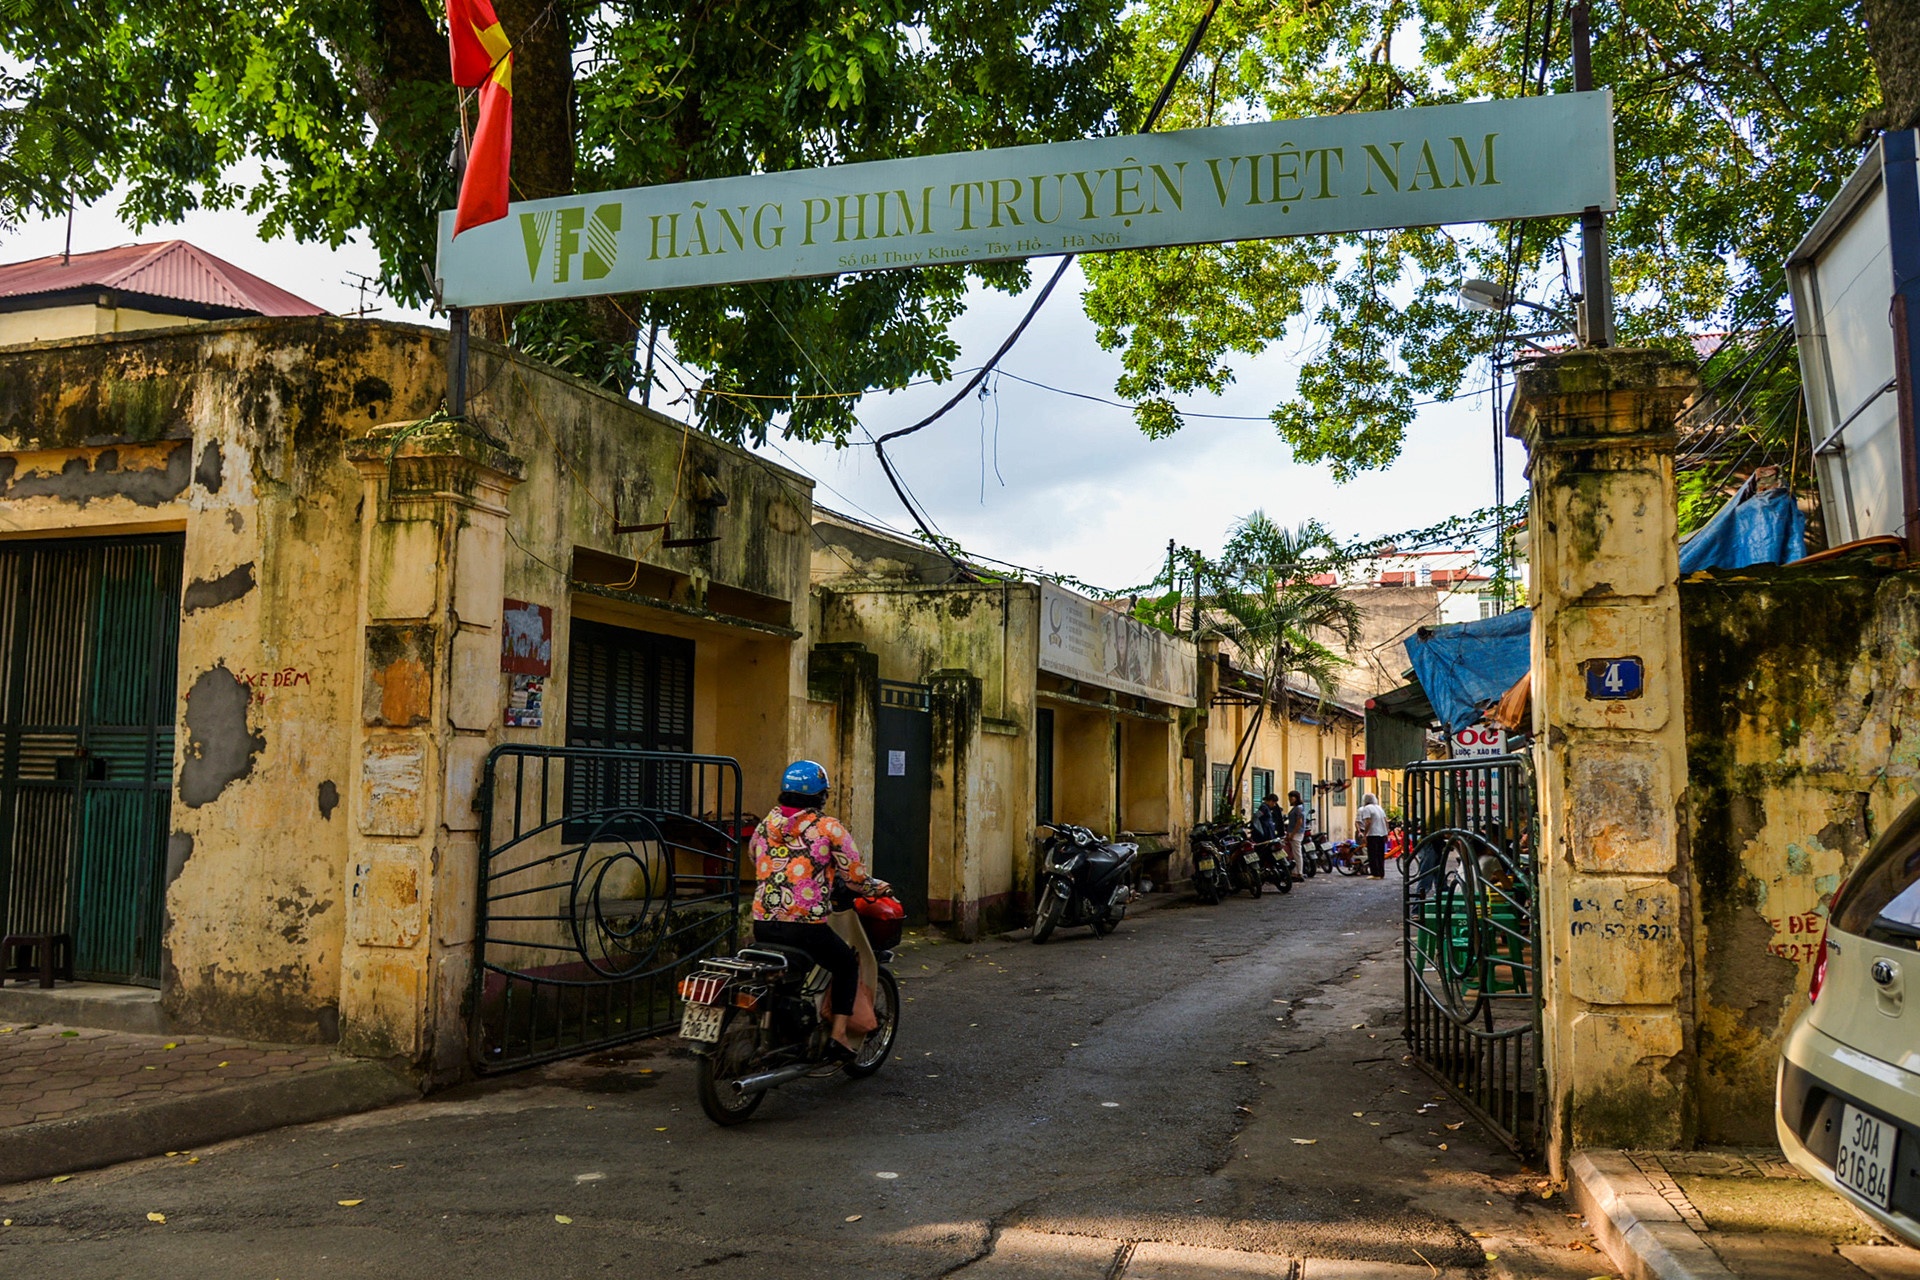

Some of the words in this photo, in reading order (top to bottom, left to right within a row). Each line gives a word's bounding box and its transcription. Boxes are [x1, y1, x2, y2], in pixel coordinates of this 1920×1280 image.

[646, 201, 787, 262] HÃNG
[800, 186, 937, 247] PHIM
[950, 157, 1188, 231] TRUYỆN
[1205, 141, 1345, 214] VIỆT
[1361, 132, 1502, 195] NAM
[518, 202, 622, 285] VFS
[838, 252, 858, 268] Số
[861, 253, 878, 266] 04
[928, 245, 970, 260] Khuê
[985, 242, 1011, 257] Tây
[1062, 235, 1085, 248] Hà
[1091, 232, 1121, 247] Nội
[1604, 663, 1624, 692] 4
[1852, 1113, 1880, 1158] 30A
[1838, 1145, 1886, 1203] 816.84
